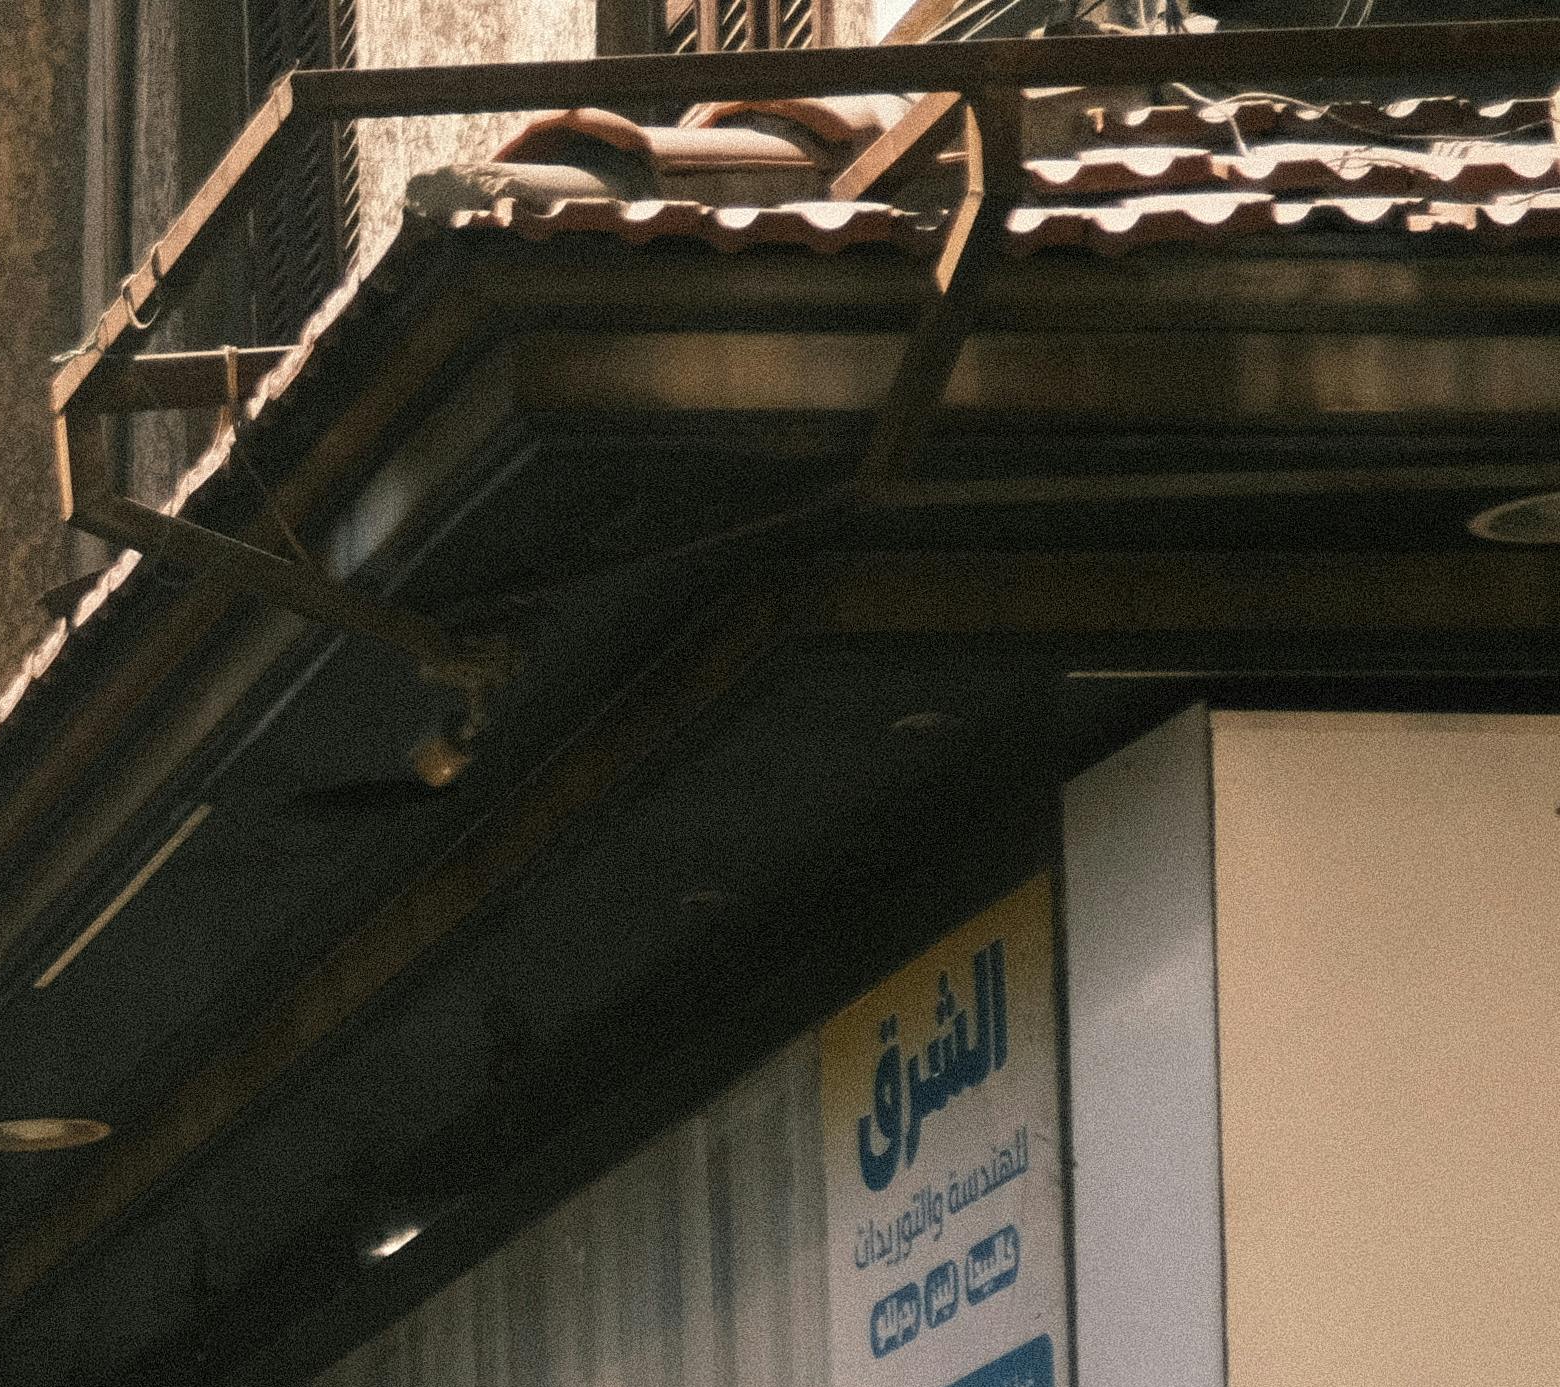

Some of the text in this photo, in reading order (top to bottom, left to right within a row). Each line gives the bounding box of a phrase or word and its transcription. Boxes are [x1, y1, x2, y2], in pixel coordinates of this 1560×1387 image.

[858, 939, 1007, 1191] الشرق
[854, 1125, 1028, 1269] للهندسة والتوريدات
